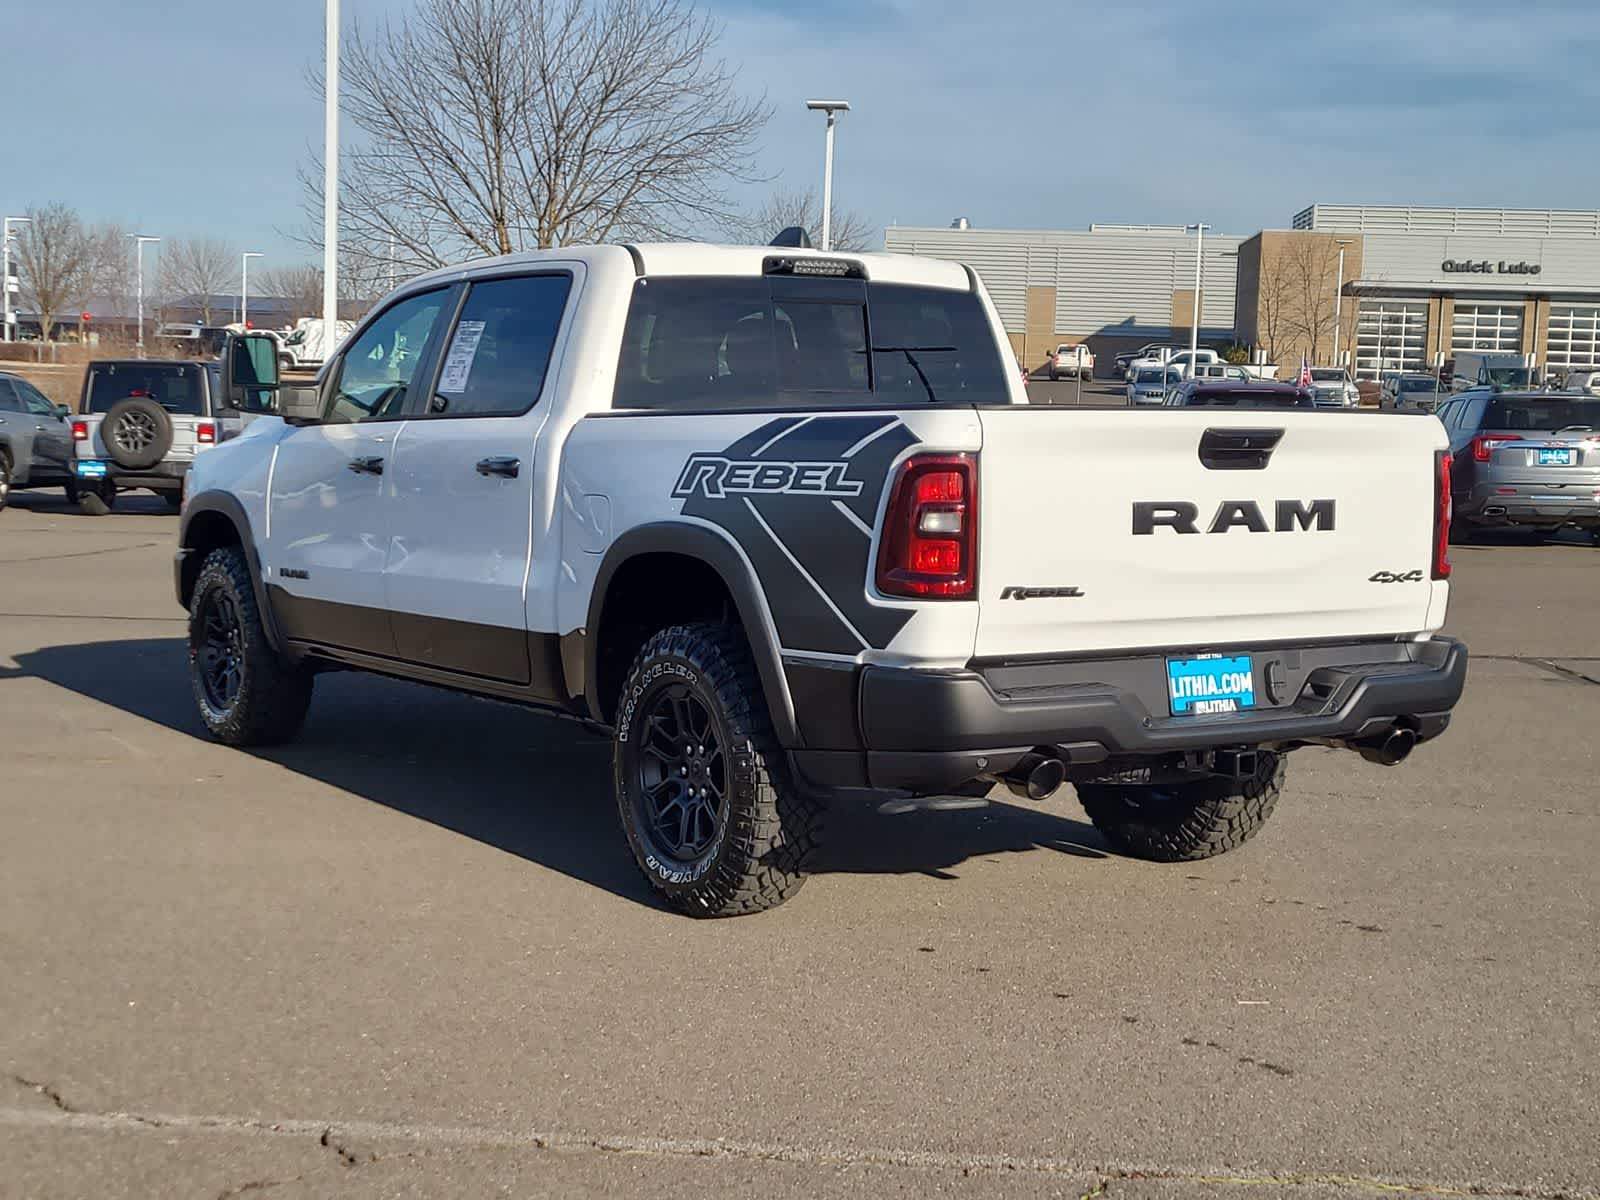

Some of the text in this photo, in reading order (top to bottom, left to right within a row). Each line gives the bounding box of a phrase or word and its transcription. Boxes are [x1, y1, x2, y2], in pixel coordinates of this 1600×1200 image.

[1442, 260, 1541, 275] Quick Lube
[674, 456, 865, 499] REBEL
[1131, 499, 1336, 535] RAM
[1367, 569, 1424, 584] 4x4
[999, 586, 1086, 601] REBEL
[1170, 671, 1253, 699] LITHIA.COM
[619, 662, 698, 742] WRANGLER
[1206, 698, 1238, 713] LITHIA
[645, 799, 730, 884] GOODYEAR
